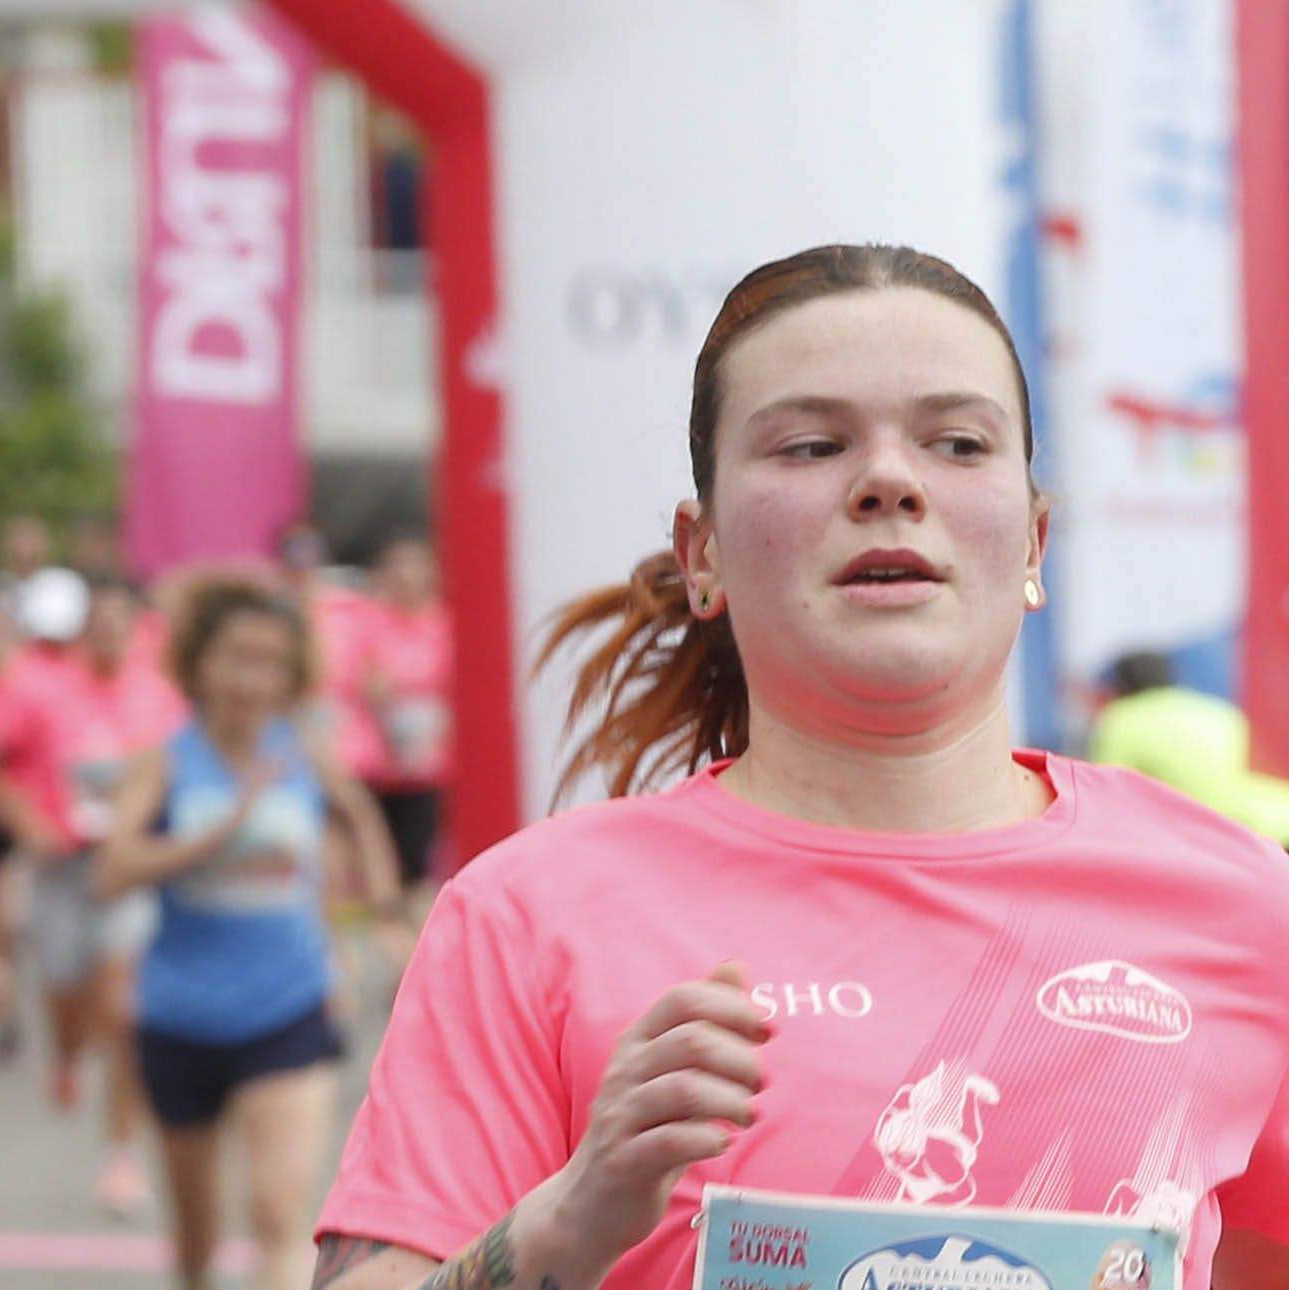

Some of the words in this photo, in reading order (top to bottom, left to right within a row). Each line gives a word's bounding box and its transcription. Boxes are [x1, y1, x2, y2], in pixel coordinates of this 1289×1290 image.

[750, 979, 874, 1022] SHO
[1054, 984, 1184, 1034] ASTURIANA
[728, 1236, 807, 1269] SUMA
[1099, 1247, 1146, 1289] 20
